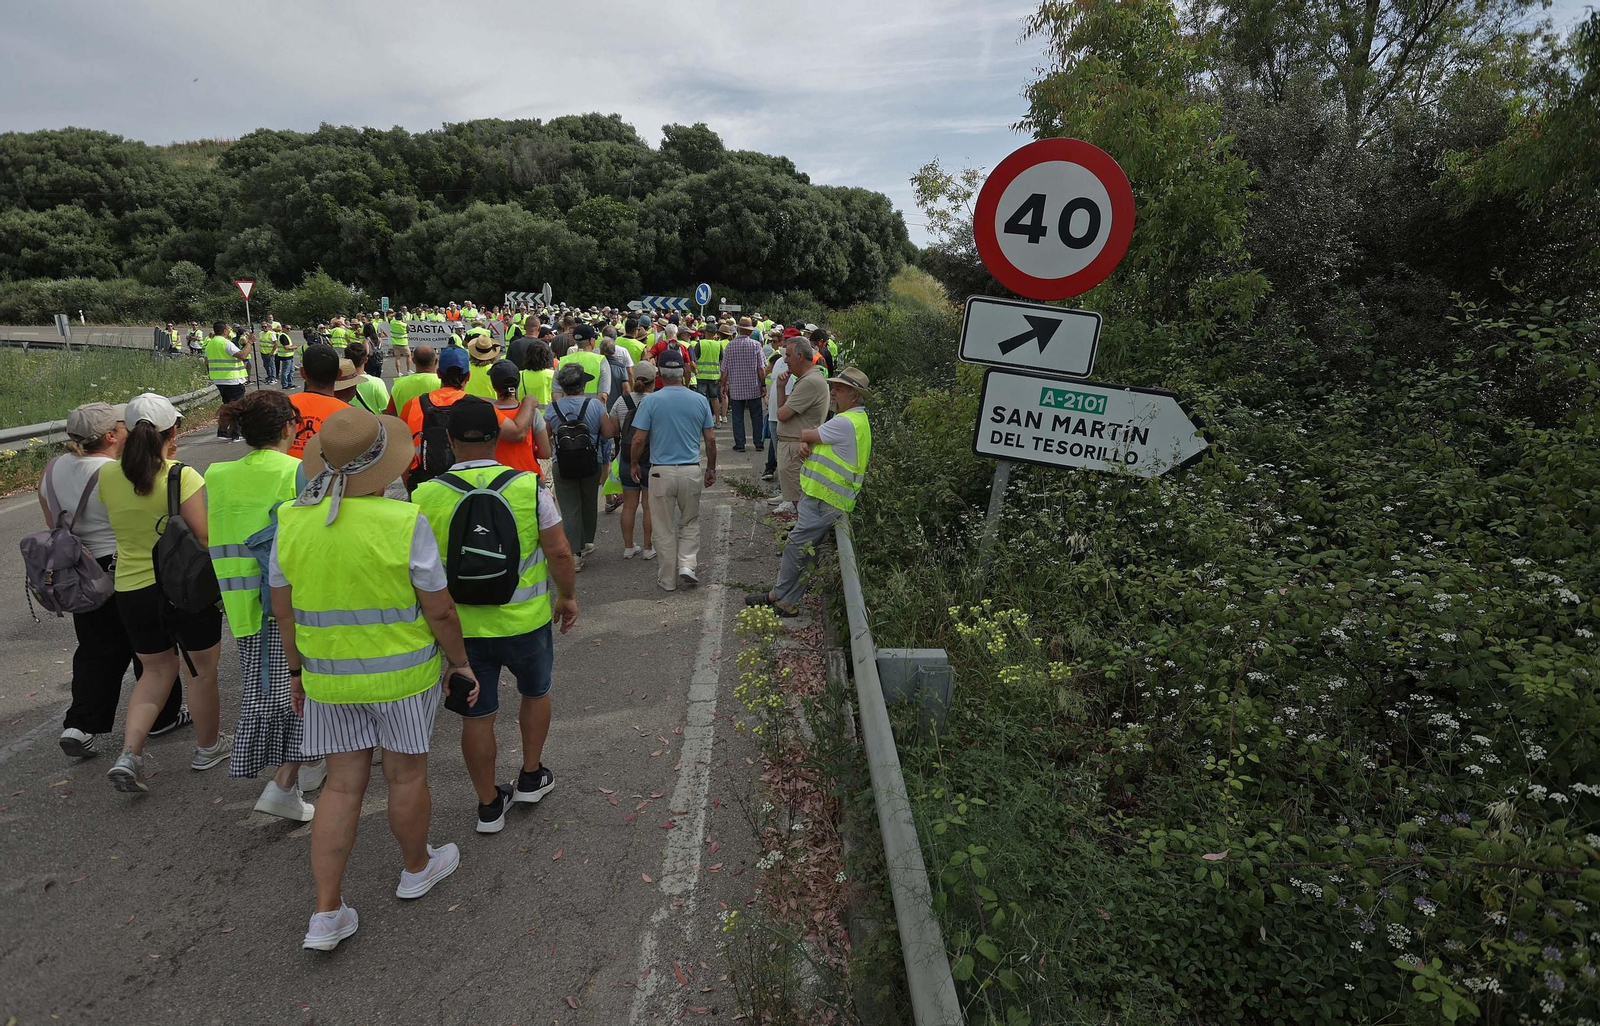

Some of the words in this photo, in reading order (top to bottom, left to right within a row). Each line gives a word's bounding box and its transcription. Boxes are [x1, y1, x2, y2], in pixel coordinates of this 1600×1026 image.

[1004, 193, 1101, 250] 40
[406, 324, 446, 334] BASTA
[1041, 390, 1106, 413] A-2101
[990, 405, 1043, 430] SAN
[1051, 414, 1149, 446] MARTÍN
[990, 430, 1025, 449] DEL
[1032, 436, 1139, 465] TESORILLO
